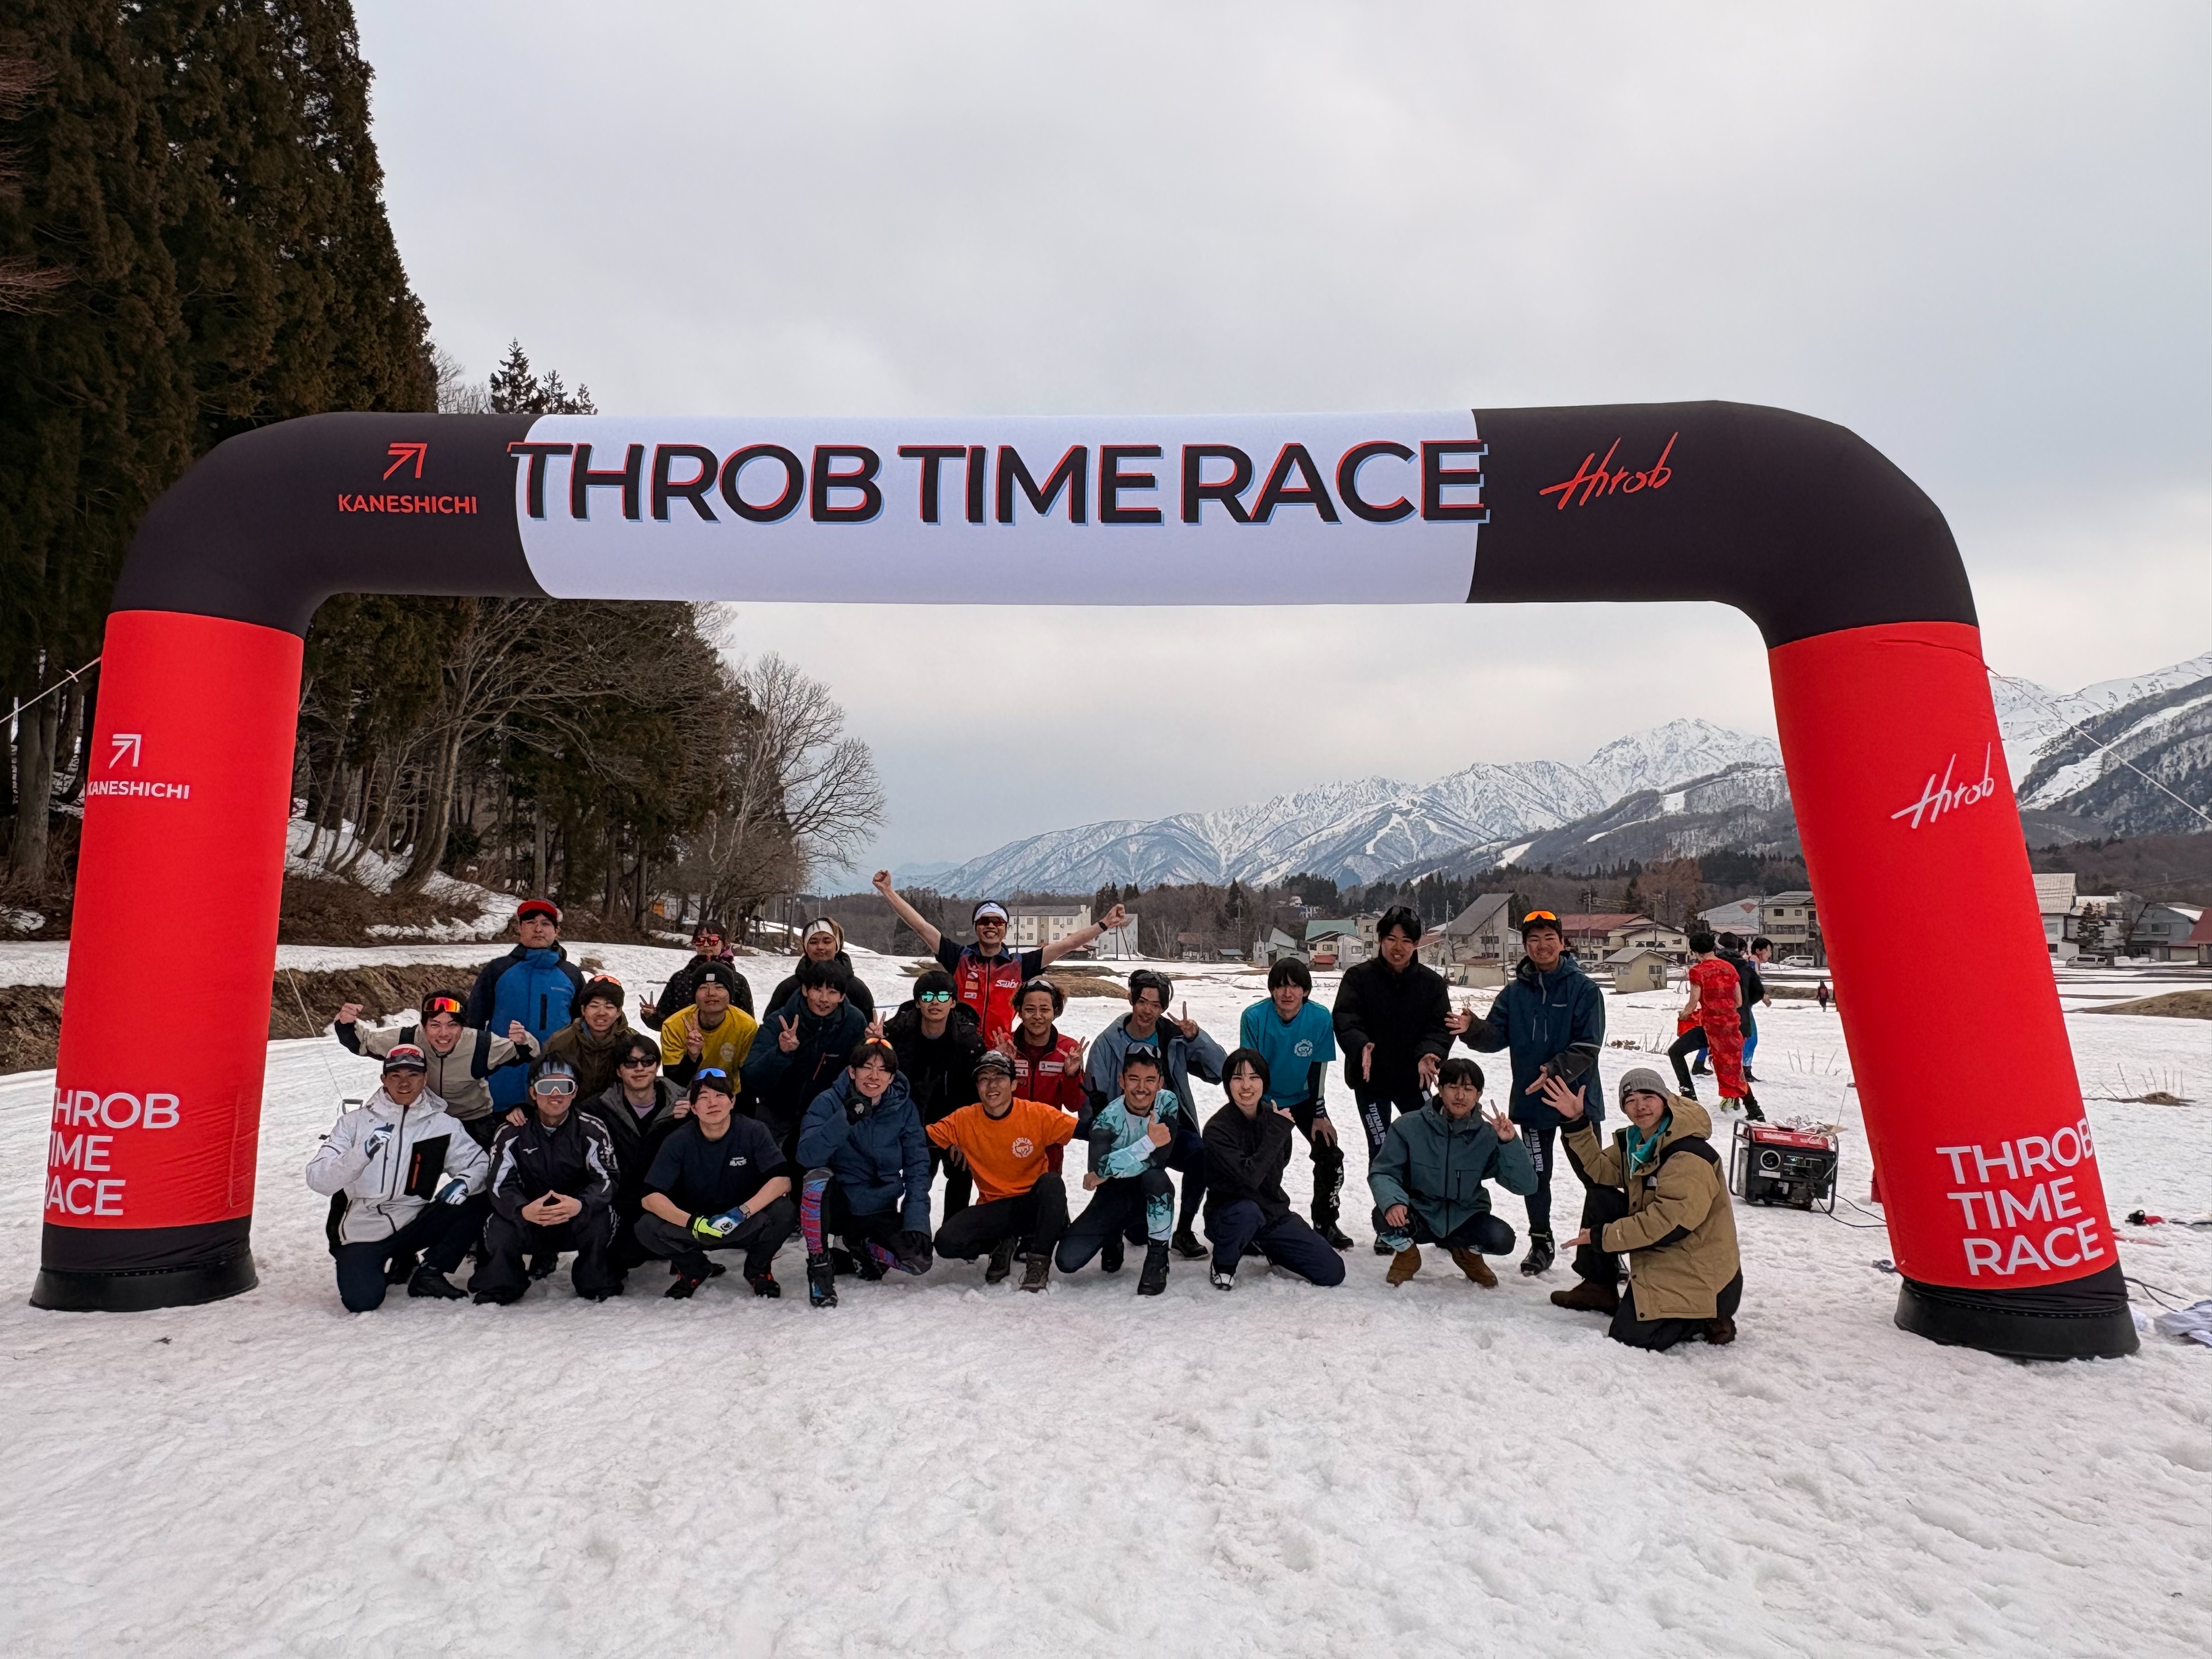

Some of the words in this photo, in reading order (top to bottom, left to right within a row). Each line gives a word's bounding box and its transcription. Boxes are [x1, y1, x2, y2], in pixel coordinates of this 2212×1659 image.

[338, 494, 477, 514] KANESHICHI
[507, 442, 884, 523] THROB
[898, 444, 1164, 526] TIME
[1181, 439, 1490, 524] RACE
[54, 1087, 180, 1129] HROB
[50, 1131, 114, 1172] IME
[1936, 1118, 2094, 1184] THROB
[1947, 1175, 2083, 1230] TIME
[1962, 1217, 2104, 1276] RACE
